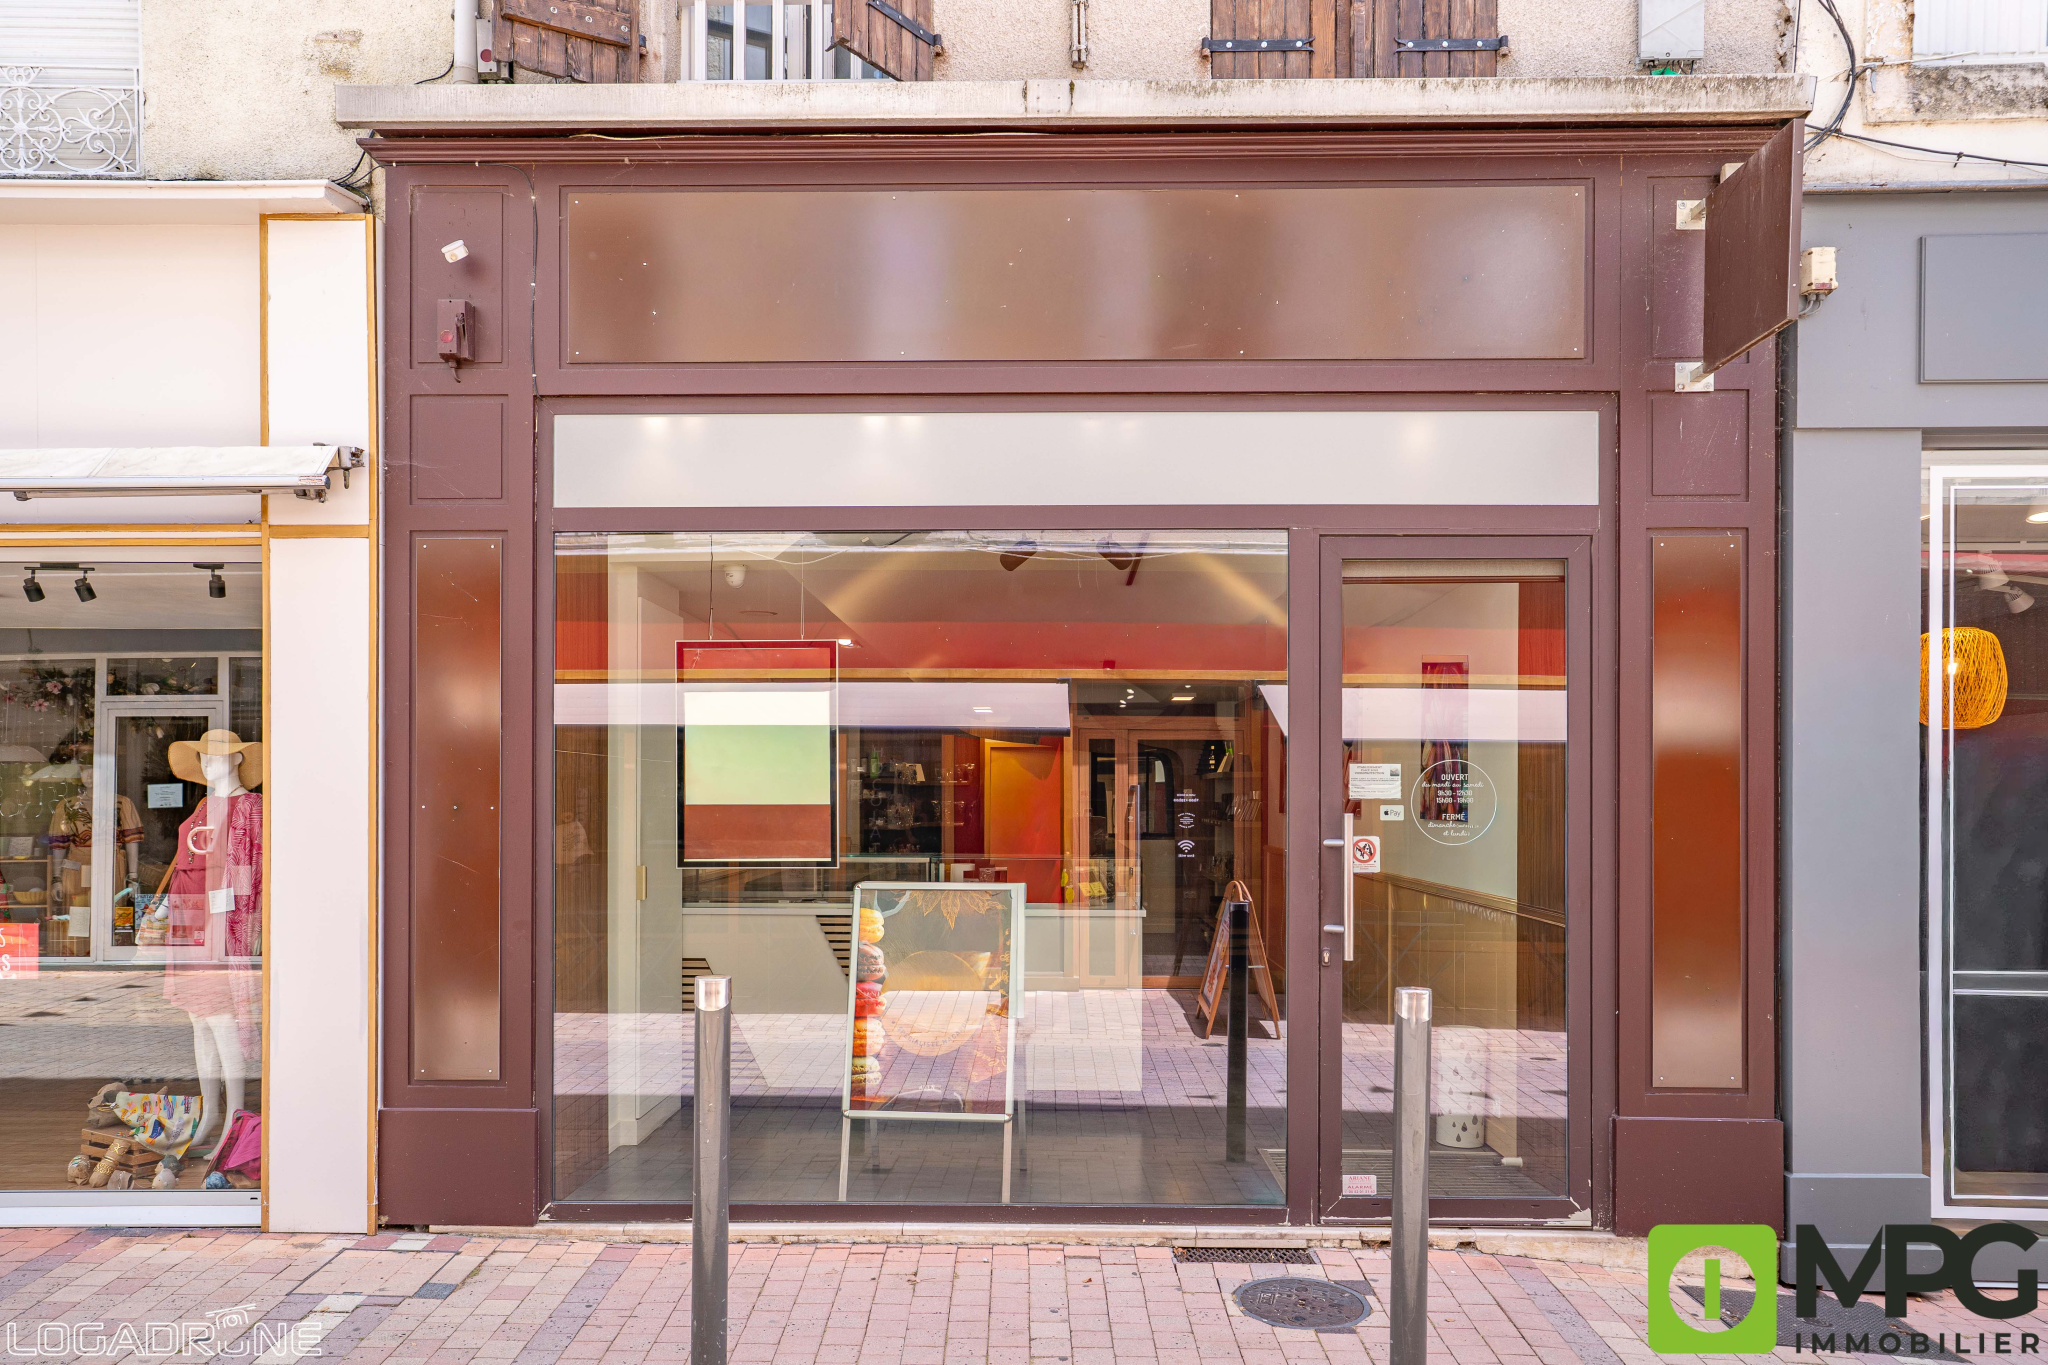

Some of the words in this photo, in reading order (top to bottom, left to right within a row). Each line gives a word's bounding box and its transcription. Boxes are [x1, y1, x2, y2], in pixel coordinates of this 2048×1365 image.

[1463, 780, 1484, 788] samedi
[1389, 809, 1401, 818] Pay
[1442, 812, 1466, 820] FERMÉ
[1427, 820, 1456, 828] dimanche
